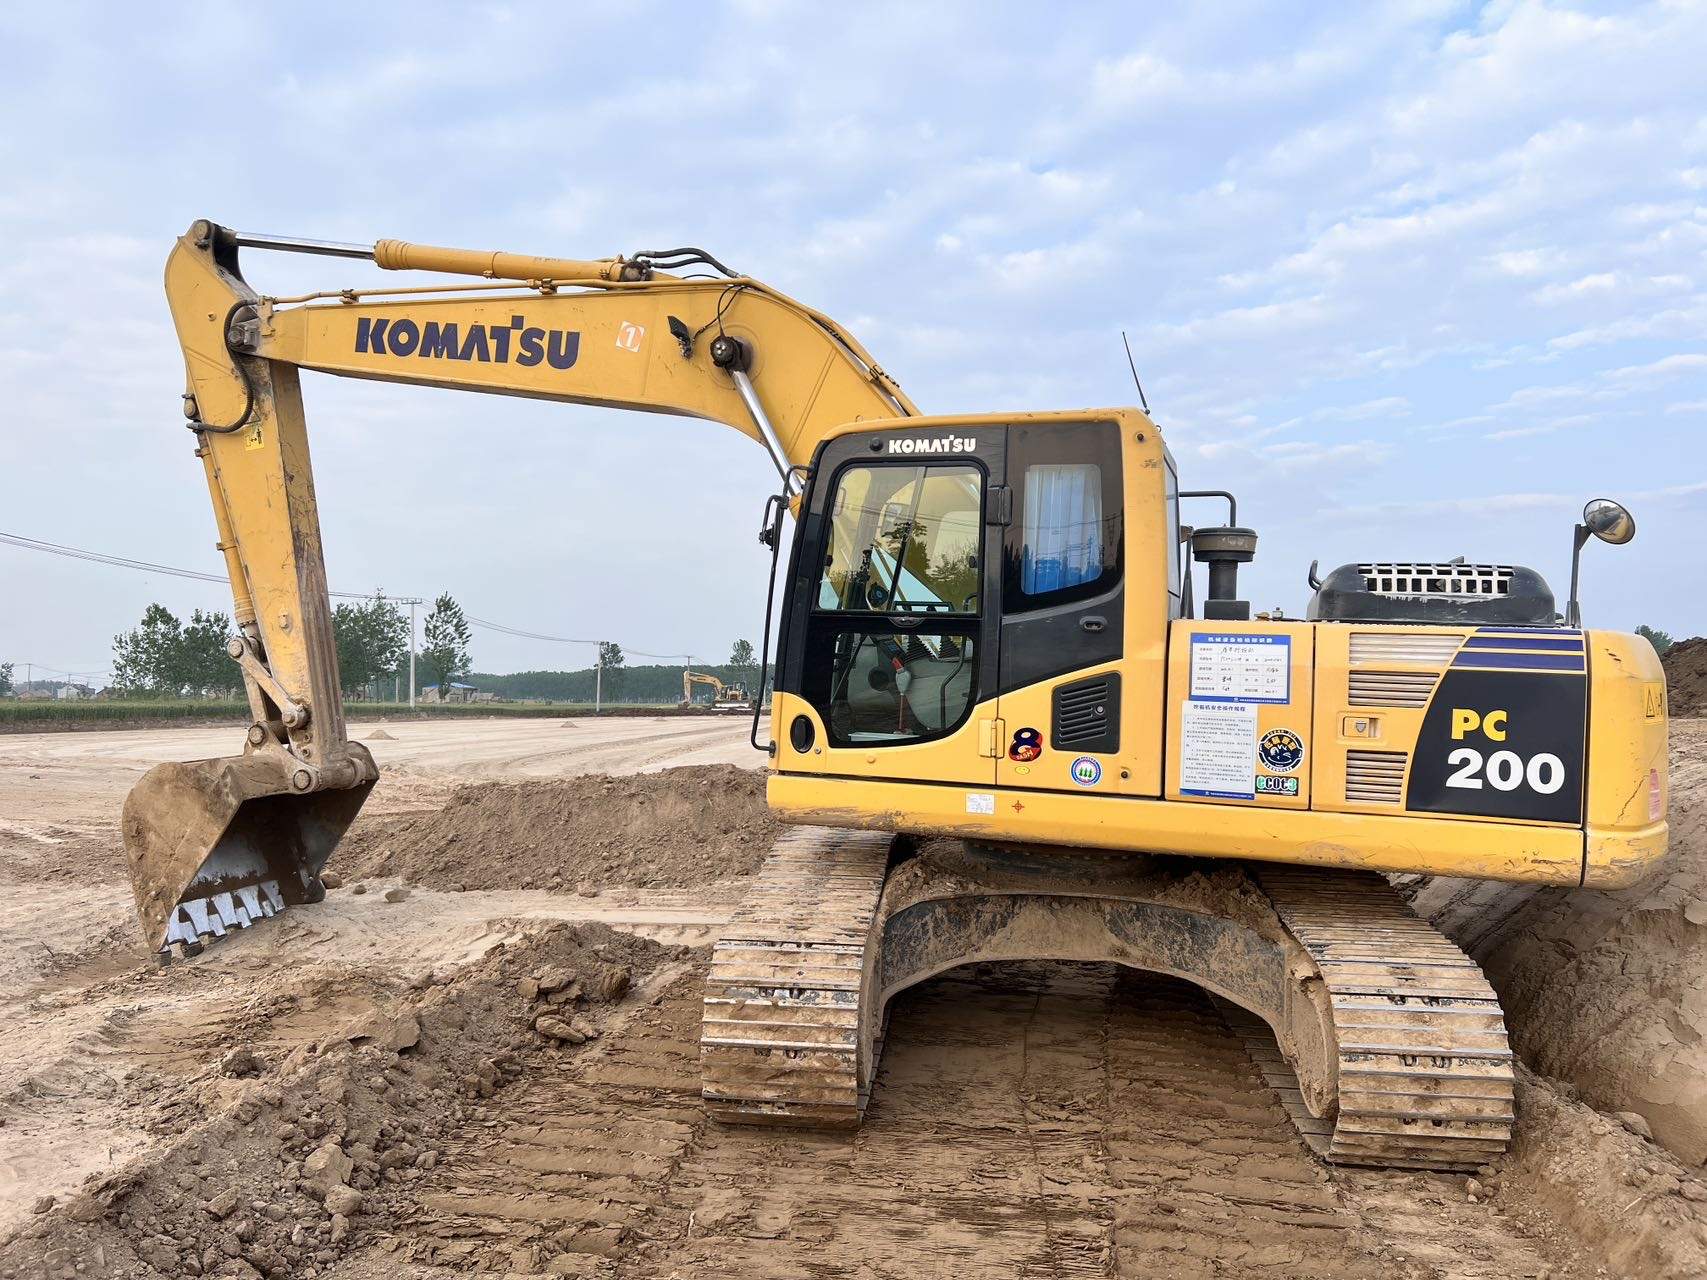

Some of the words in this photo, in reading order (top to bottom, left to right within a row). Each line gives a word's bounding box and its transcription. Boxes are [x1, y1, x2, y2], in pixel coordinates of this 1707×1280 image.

[355, 315, 580, 370] KOMATSU
[889, 434, 976, 454] KOMATSU
[1450, 708, 1508, 742] PC
[1009, 727, 1043, 762] 8
[1445, 747, 1566, 795] 200
